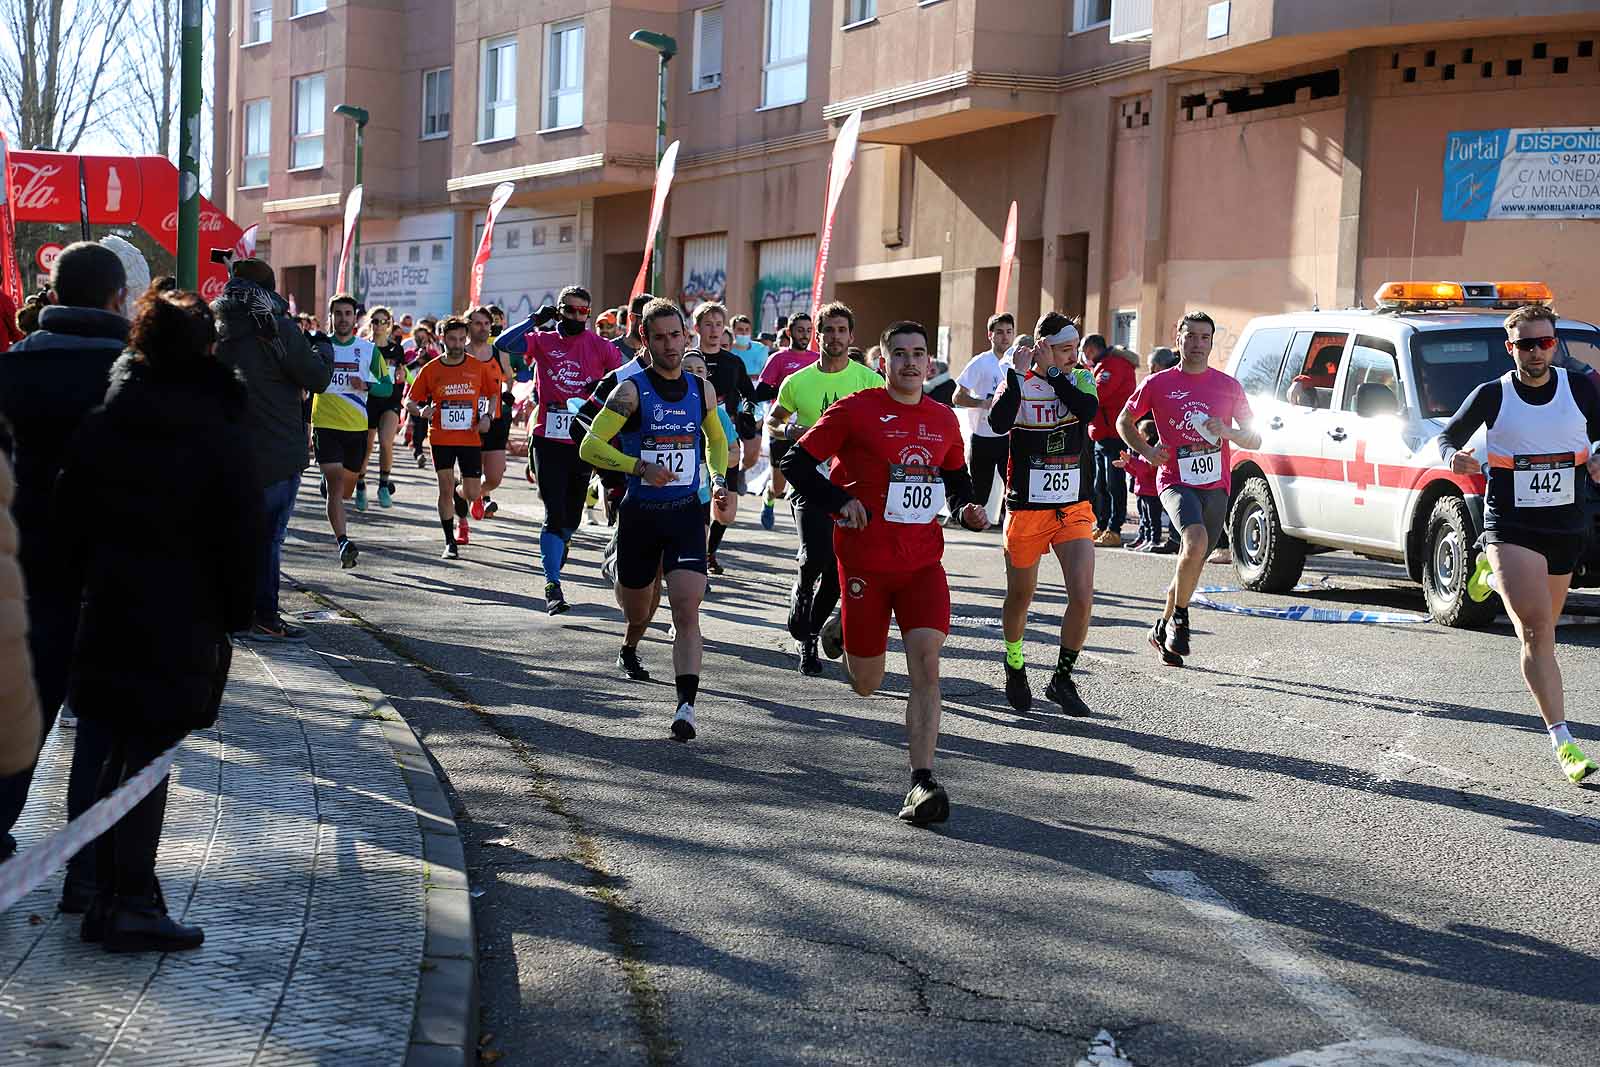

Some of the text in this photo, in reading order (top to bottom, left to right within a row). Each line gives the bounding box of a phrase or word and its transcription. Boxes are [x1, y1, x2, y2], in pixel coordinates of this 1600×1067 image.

[1450, 136, 1499, 161] Portal
[1563, 154, 1585, 164] 947
[332, 373, 349, 385] 461
[449, 411, 465, 422] 504
[656, 453, 684, 473] 512
[1191, 457, 1214, 475] 490
[1043, 473, 1070, 492] 265
[1529, 472, 1562, 494] 442
[903, 486, 932, 509] 508
